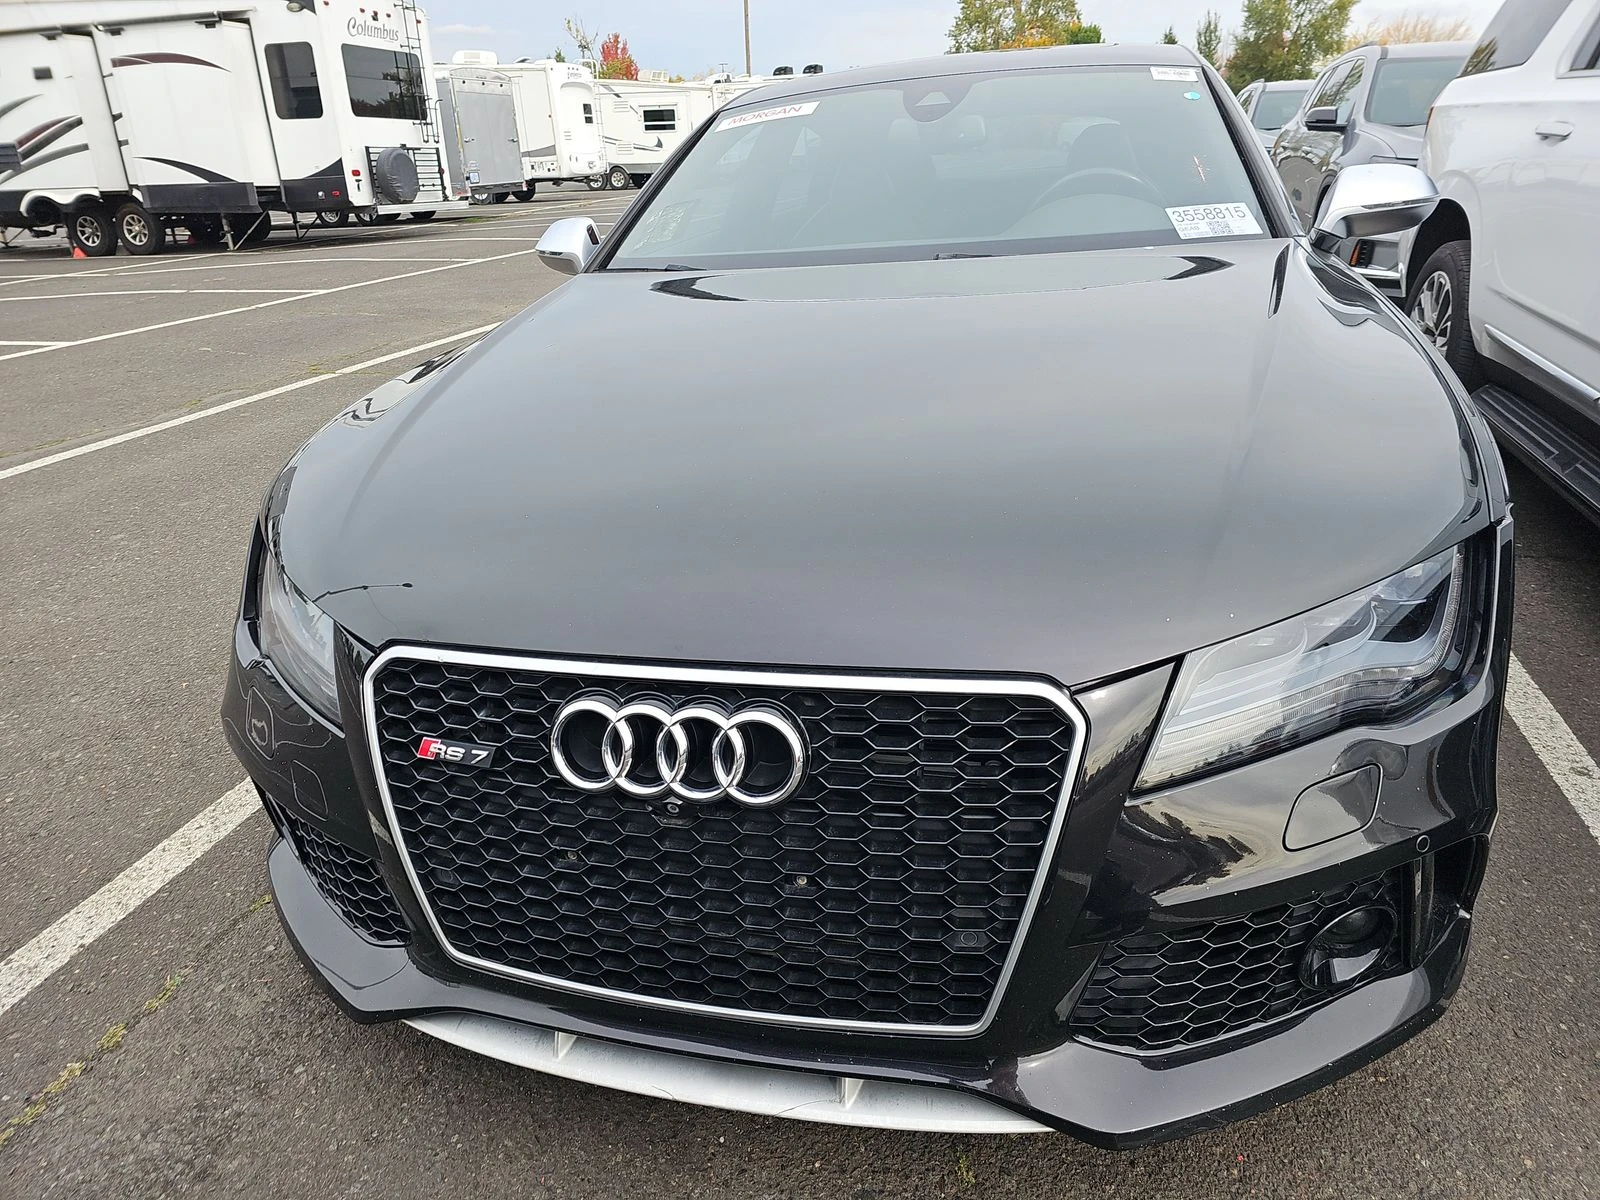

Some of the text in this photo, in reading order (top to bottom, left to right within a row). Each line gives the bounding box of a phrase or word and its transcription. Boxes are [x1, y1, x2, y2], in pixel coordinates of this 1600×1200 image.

[347, 16, 399, 42] Columbus
[728, 105, 803, 126] MORGAN
[1172, 206, 1246, 224] 3558815
